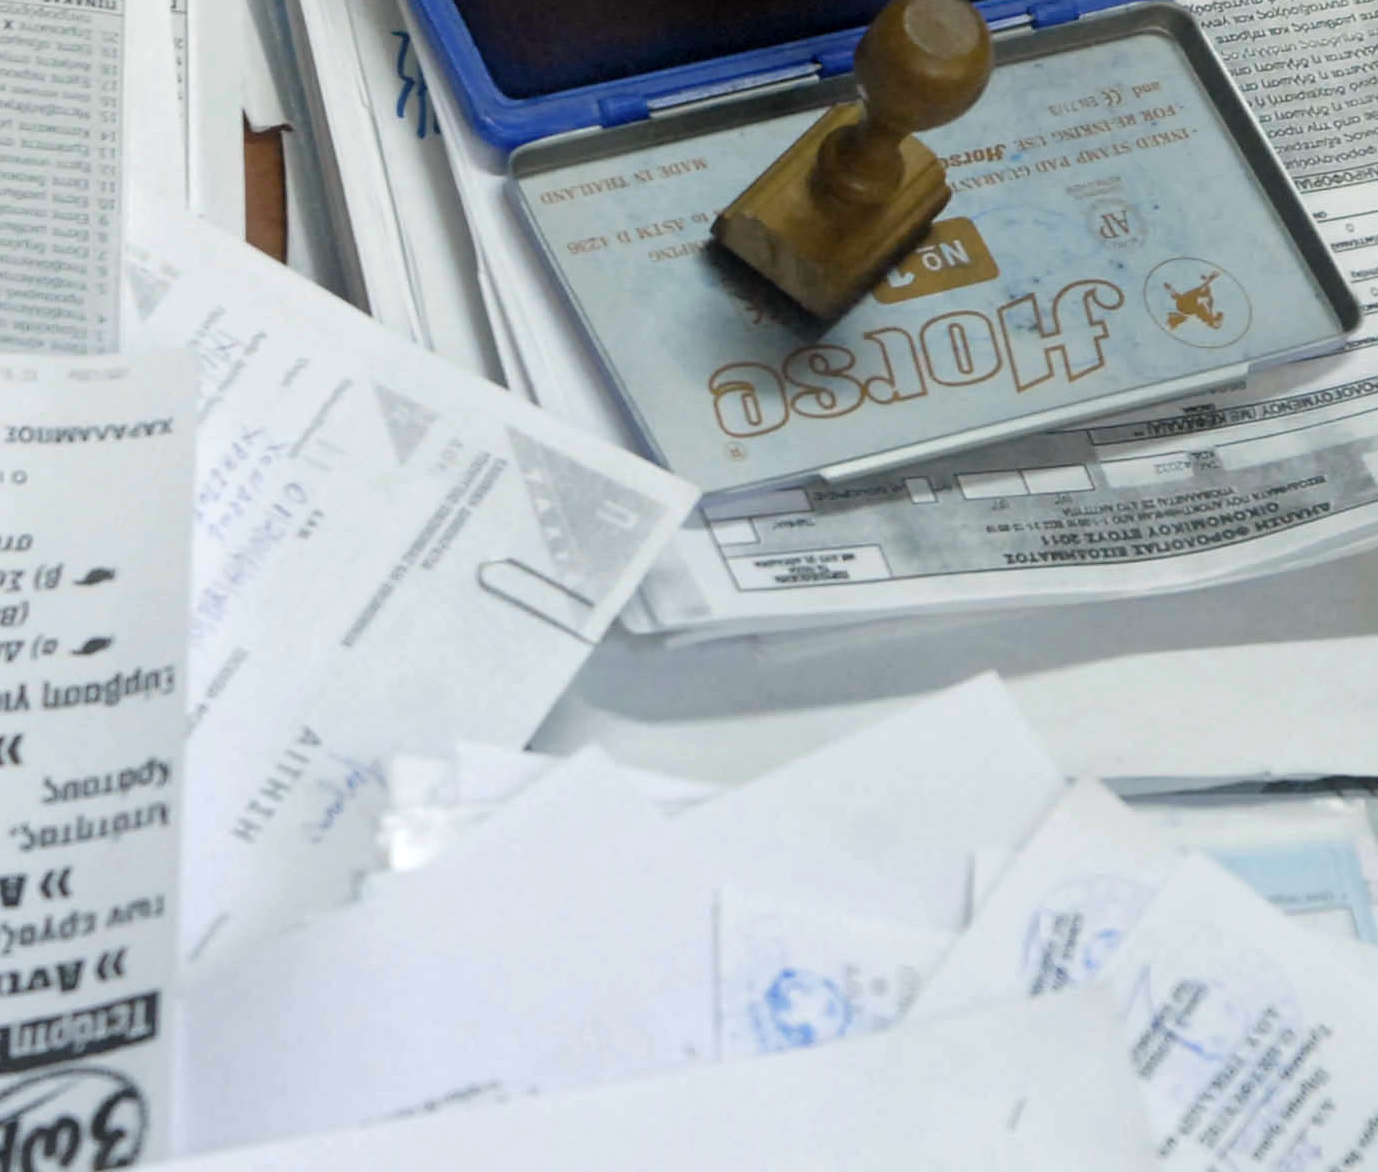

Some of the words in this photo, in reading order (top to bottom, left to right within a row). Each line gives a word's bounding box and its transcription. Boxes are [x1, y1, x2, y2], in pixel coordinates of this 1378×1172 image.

[1132, 81, 1160, 98] and
[1141, 104, 1176, 121] FOR
[1135, 127, 1189, 151] INKED
[1034, 155, 1071, 174] PAD
[1076, 140, 1131, 165] STAMP
[633, 169, 653, 183] IN
[659, 157, 709, 180] MADE
[947, 166, 1030, 193] GUARANT
[540, 175, 630, 205] THAILAND
[635, 217, 684, 241] ASTM
[691, 211, 708, 224] to
[1099, 210, 1132, 240] AP
[648, 240, 705, 262] MPING
[708, 279, 1124, 438] Horse
[3, 417, 174, 445] ΧΑΡΑΛΑΜΠΟΣ
[1148, 501, 1279, 534] ΟΙΚΟΝΟΜΙΚΟΥ
[1256, 501, 1332, 532] ΔΗΛΩΣΗ
[1041, 532, 1080, 546] 2011
[1085, 527, 1143, 543] ΕΤΟΥΣ
[1134, 523, 1250, 556] ΦΟΡΟΛΟΓΙΑΣ
[1002, 546, 1127, 566] ΕΙΣΟΔΗΜΑΤΟΣ
[229, 725, 323, 845] ΑΙΤΗΣΗ
[9, 997, 153, 1062] Τετάρτη
